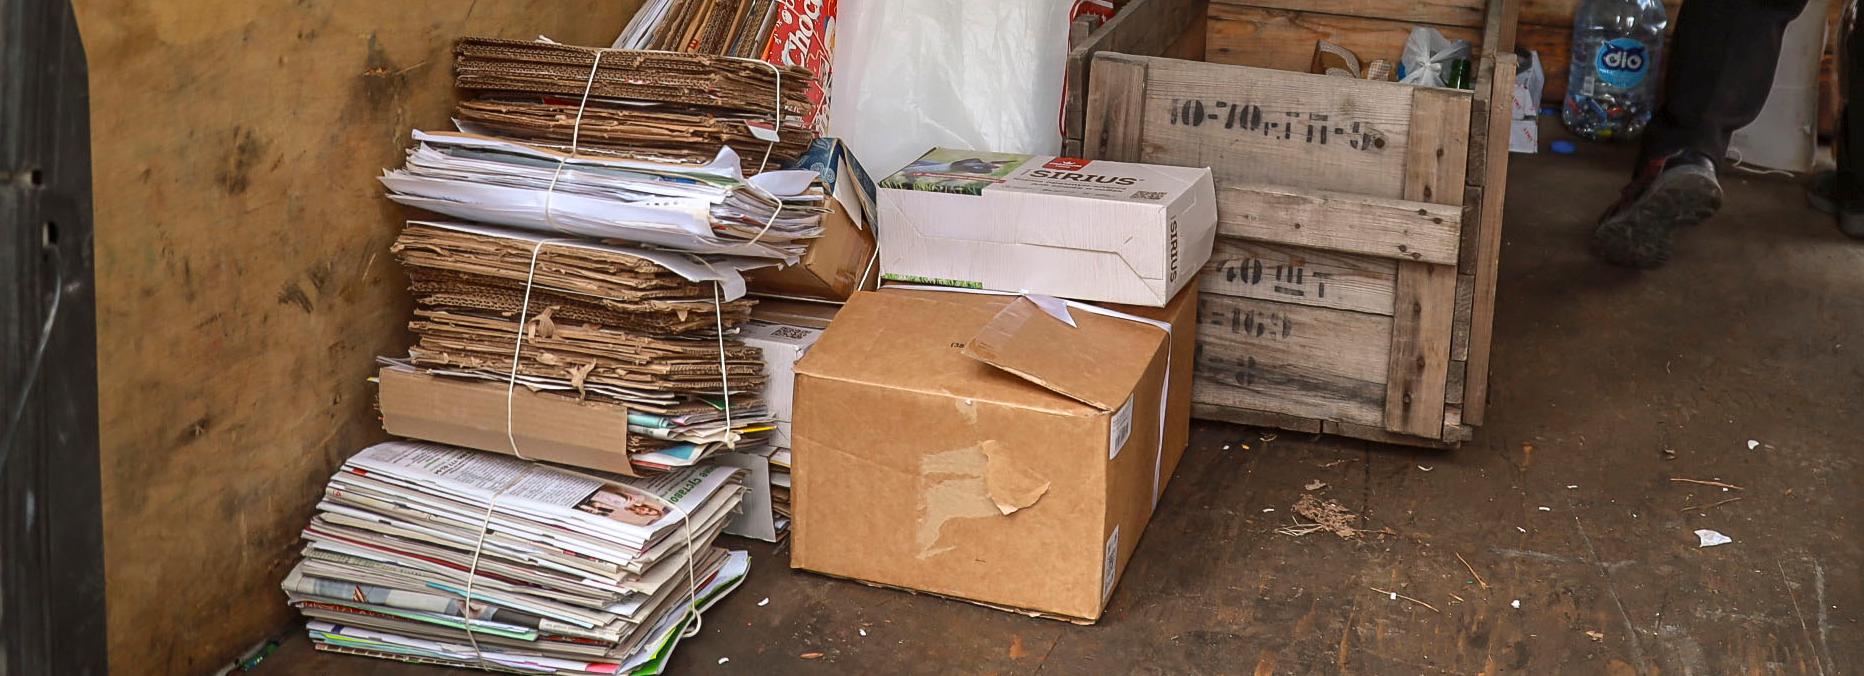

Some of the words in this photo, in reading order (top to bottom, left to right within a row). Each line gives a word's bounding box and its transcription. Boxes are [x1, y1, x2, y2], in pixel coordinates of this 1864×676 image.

[782, 0, 823, 68] Choc
[1030, 170, 1138, 186] SIRIUS
[1170, 220, 1178, 283] SIRIUS
